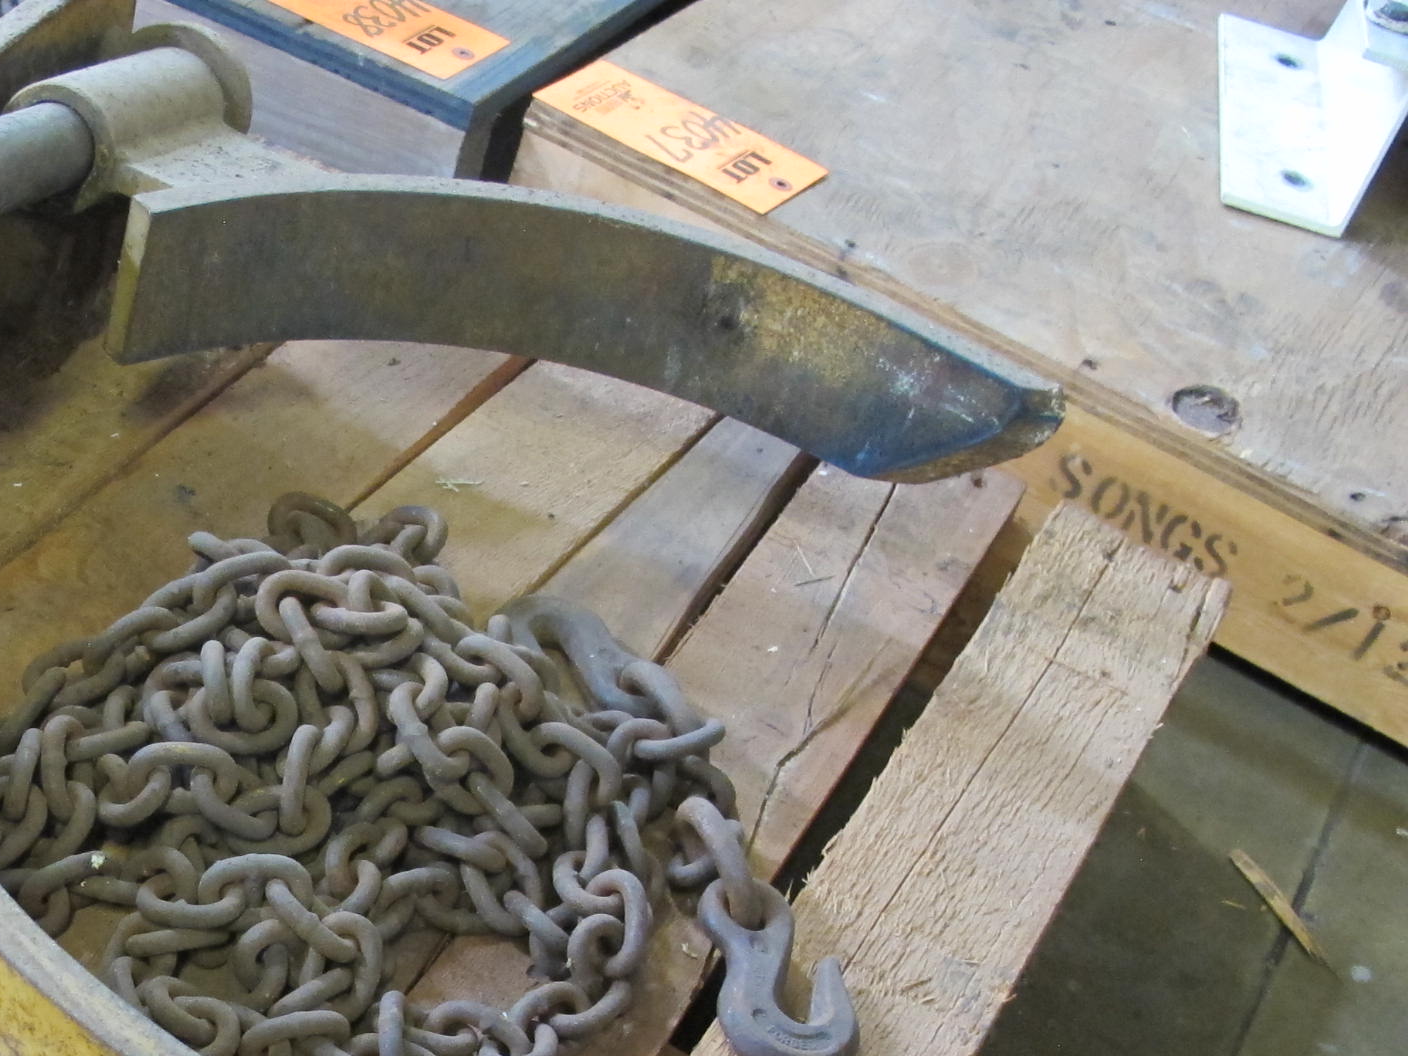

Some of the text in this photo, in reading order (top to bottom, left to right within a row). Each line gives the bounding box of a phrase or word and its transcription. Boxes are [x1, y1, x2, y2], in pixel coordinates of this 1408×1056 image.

[406, 26, 456, 55] LOT
[572, 79, 632, 113] AUCTIONS
[644, 110, 742, 164] 4037
[720, 151, 773, 184] LOT
[1050, 453, 1239, 579] SONGS
